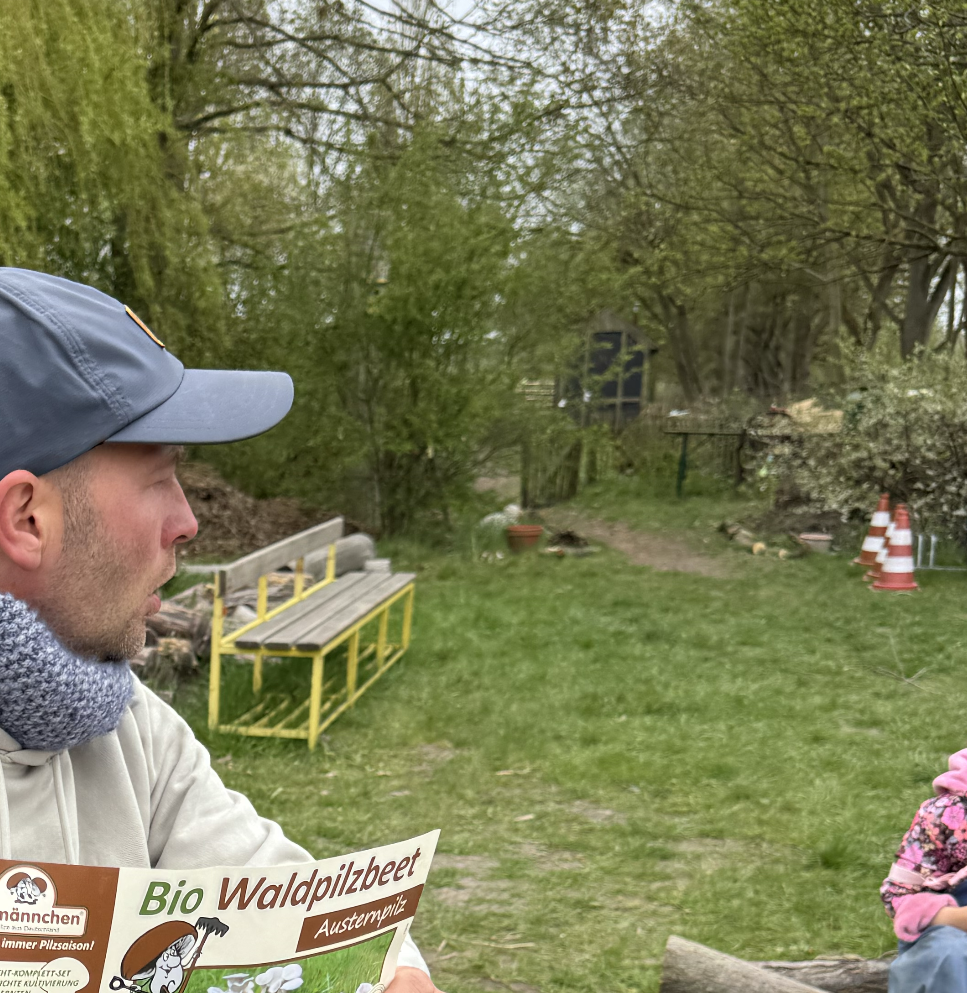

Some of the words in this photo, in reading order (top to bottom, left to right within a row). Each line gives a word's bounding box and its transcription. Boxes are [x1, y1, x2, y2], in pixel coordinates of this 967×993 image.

[138, 879, 204, 917] Bio
[217, 847, 422, 912] Waldpilzbeet
[313, 894, 408, 940] Austernpilz
[1, 937, 38, 951] immer
[39, 939, 95, 951] Pilzsaison!
[23, 979, 80, 988] KULTIVIERUNG
